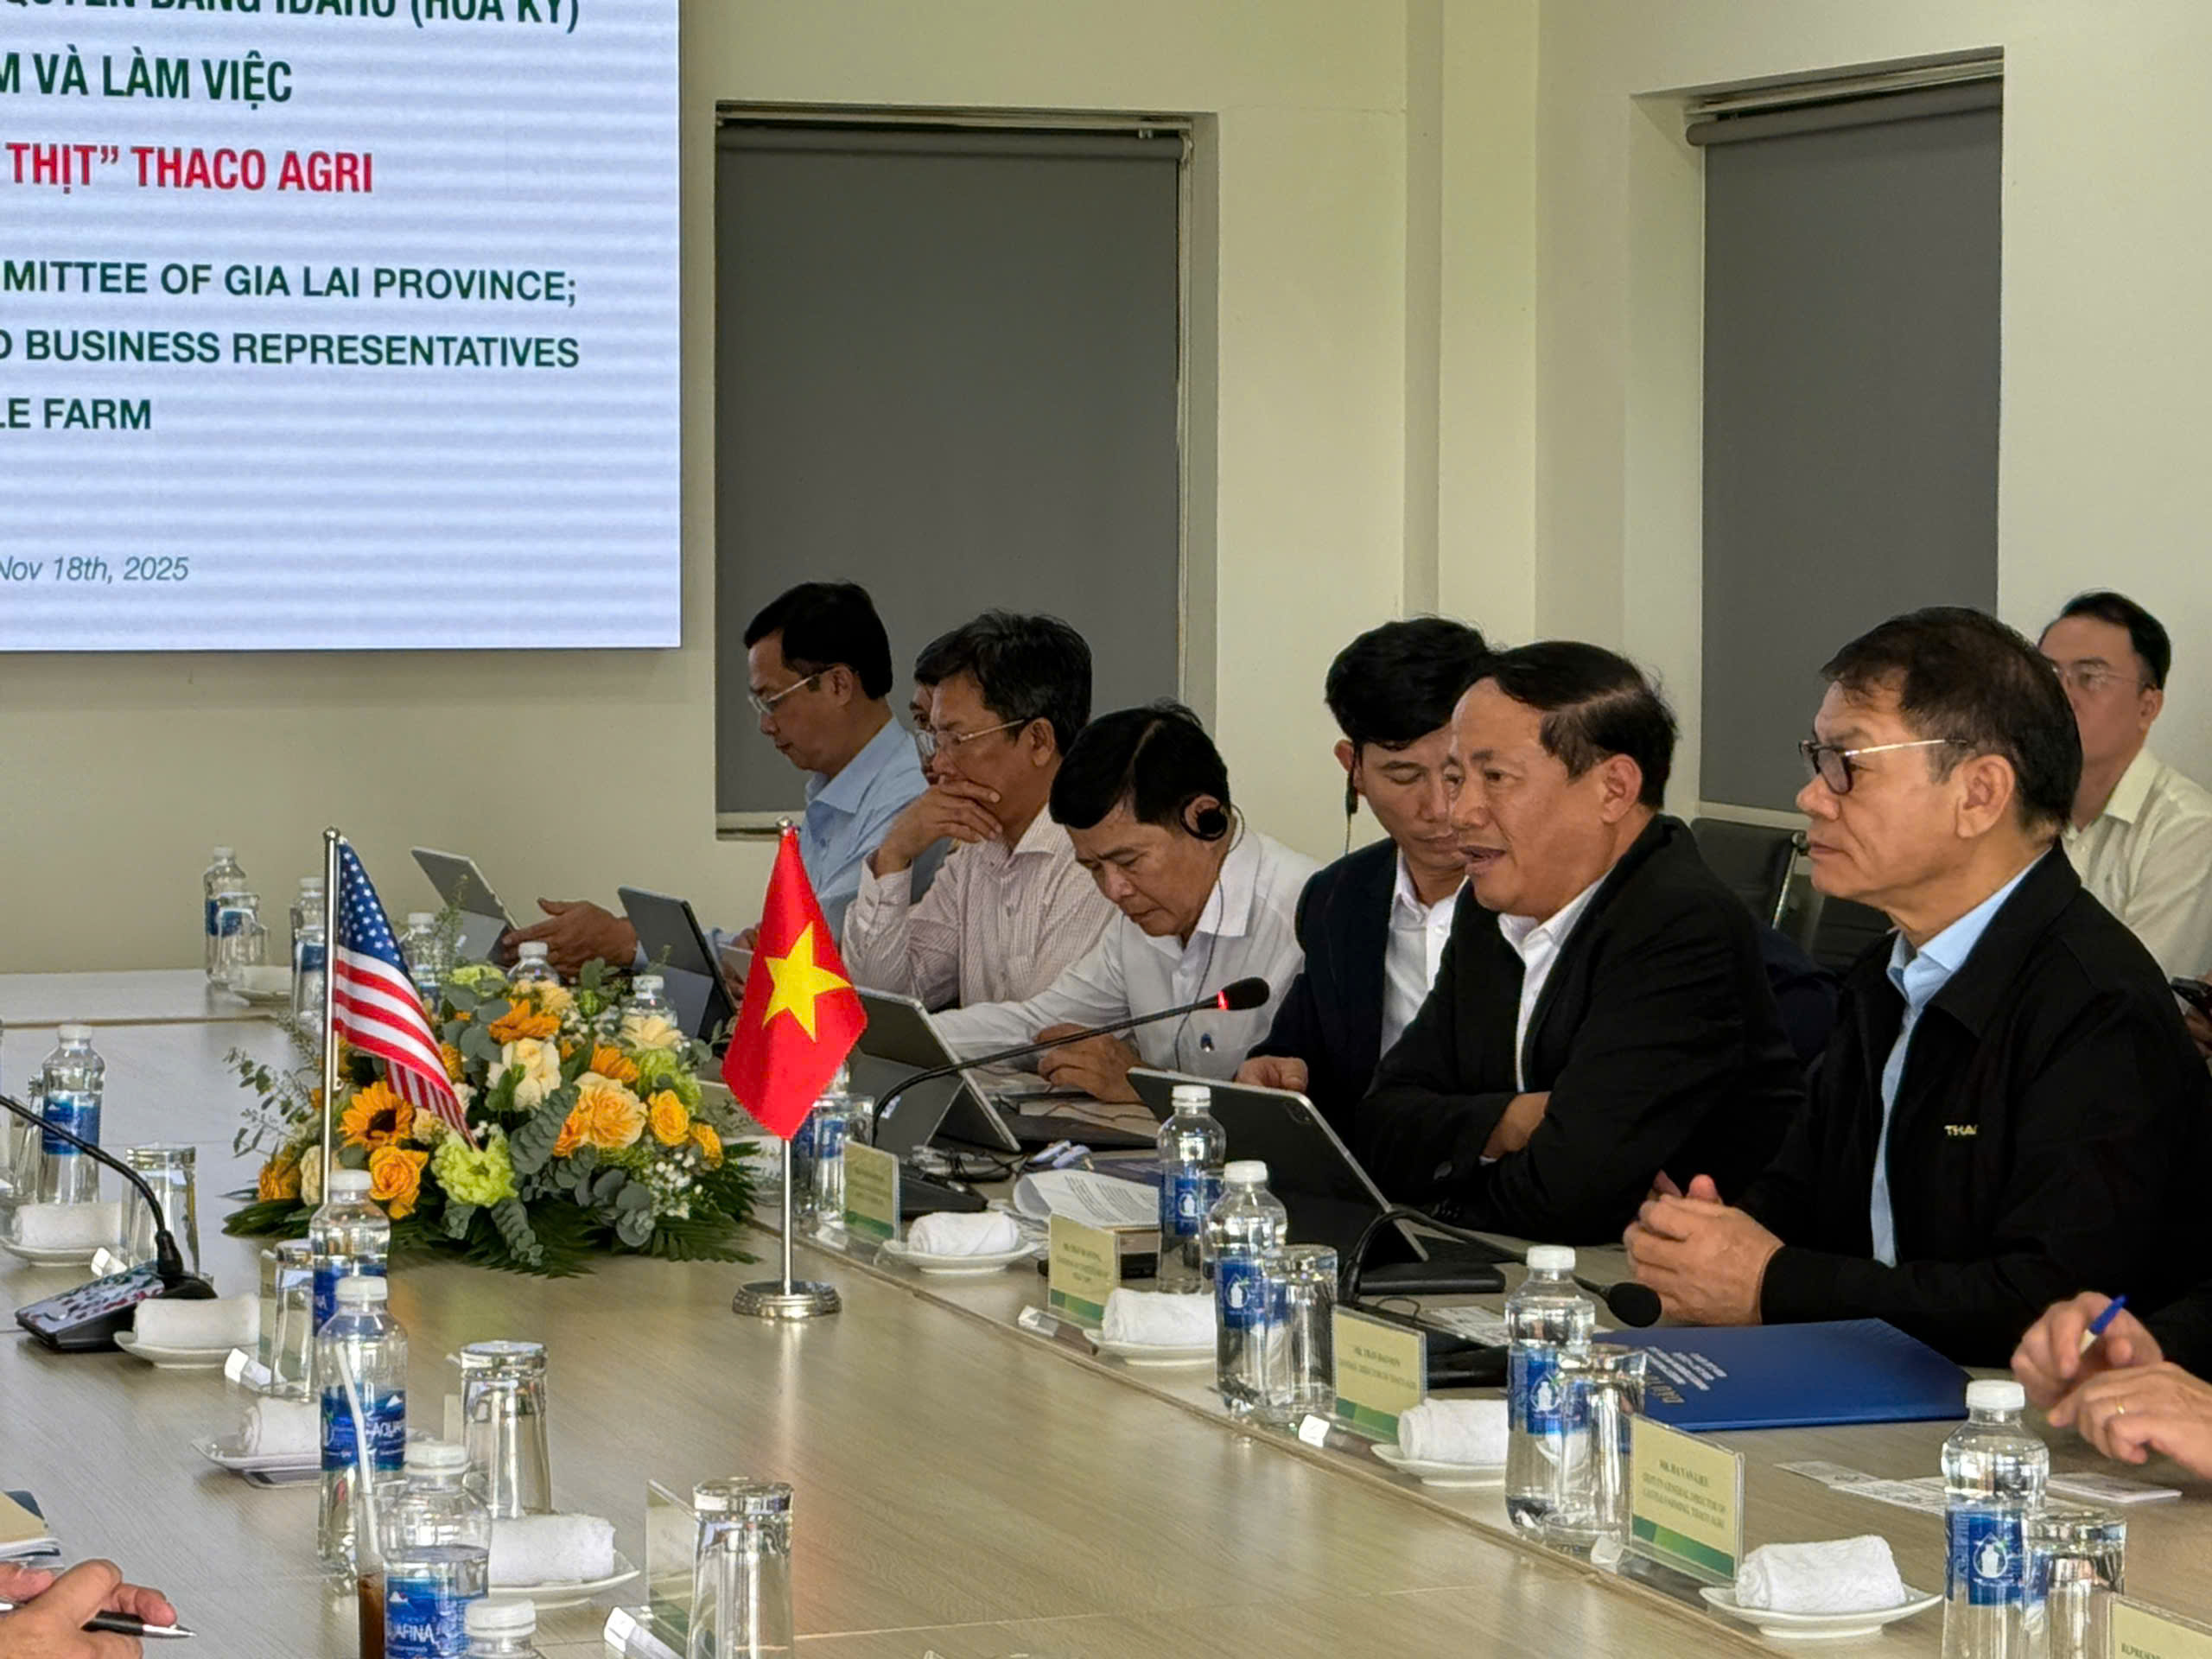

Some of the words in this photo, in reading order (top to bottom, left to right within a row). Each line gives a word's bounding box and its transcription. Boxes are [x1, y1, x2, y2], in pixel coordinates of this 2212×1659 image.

[32, 43, 89, 95] VÀ
[103, 46, 189, 99] LÀM
[201, 49, 292, 111] VIỆC
[130, 146, 266, 191] THACO
[277, 150, 372, 193] AGRI
[3, 260, 148, 294] MITTEE
[161, 264, 212, 295] OF
[225, 264, 290, 296] GIA
[303, 266, 359, 297] LAI
[373, 268, 576, 307] PROVINCE;
[26, 329, 220, 363] BUSINESS
[232, 333, 580, 368] REPRESENTATIVES
[44, 397, 151, 429] FARM
[54, 556, 113, 584] 18th,
[124, 556, 189, 581] 2025
